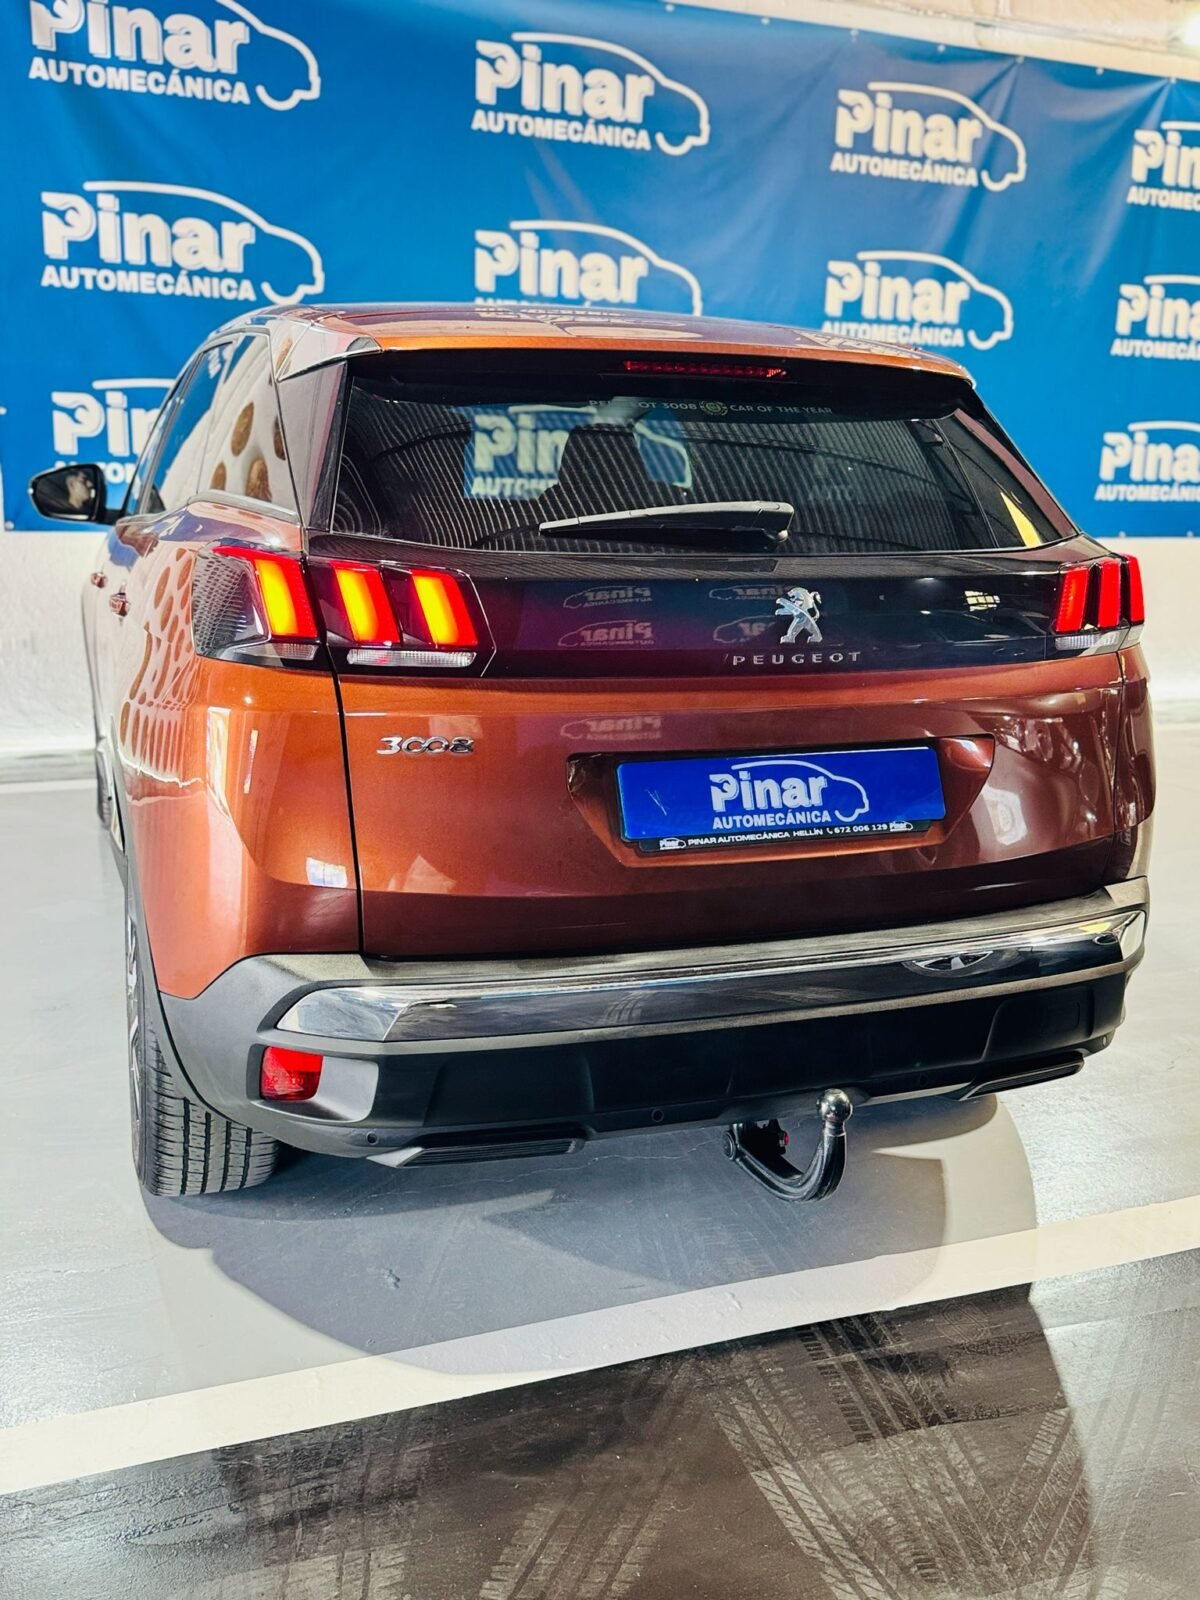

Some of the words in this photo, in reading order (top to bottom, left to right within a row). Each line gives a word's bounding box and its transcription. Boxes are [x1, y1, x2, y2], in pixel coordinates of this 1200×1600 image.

[29, 0, 250, 75] Pinar
[28, 56, 251, 105] AUTOMECÁNICA
[475, 39, 655, 124] Pinar
[470, 109, 652, 151] AUTOMECÁNICA
[835, 89, 983, 163] Pinar
[830, 151, 978, 187] AUTOMECÁNICA
[1131, 129, 1200, 189] Pin
[1126, 185, 1200, 212] AUTOMEC
[41, 191, 256, 273] Pinar
[40, 265, 257, 301] AUTOMECÁNICA
[474, 229, 649, 304] Pinar
[824, 260, 970, 325] Pinar
[1115, 284, 1200, 341] Pin
[1110, 337, 1200, 361] AUTOMECÁ
[51, 391, 161, 457] Pin
[729, 404, 754, 412] CAR
[757, 405, 772, 413] OF
[776, 406, 801, 414] THE
[802, 406, 833, 415] YEAR
[474, 414, 570, 474] Pin
[1099, 430, 1200, 483] Pina
[1093, 482, 1200, 502] AUTOMECÁNI
[732, 651, 861, 666] PEUGEOT
[376, 735, 475, 755] 3008
[709, 771, 828, 813] Pinar
[687, 836, 718, 847] PINAR
[718, 831, 790, 844] AUTOMECÁNICA
[712, 809, 832, 830] AUTOMECÁNICA
[834, 826, 851, 834] 672
[852, 824, 870, 833] 006
[871, 823, 888, 831] 129
